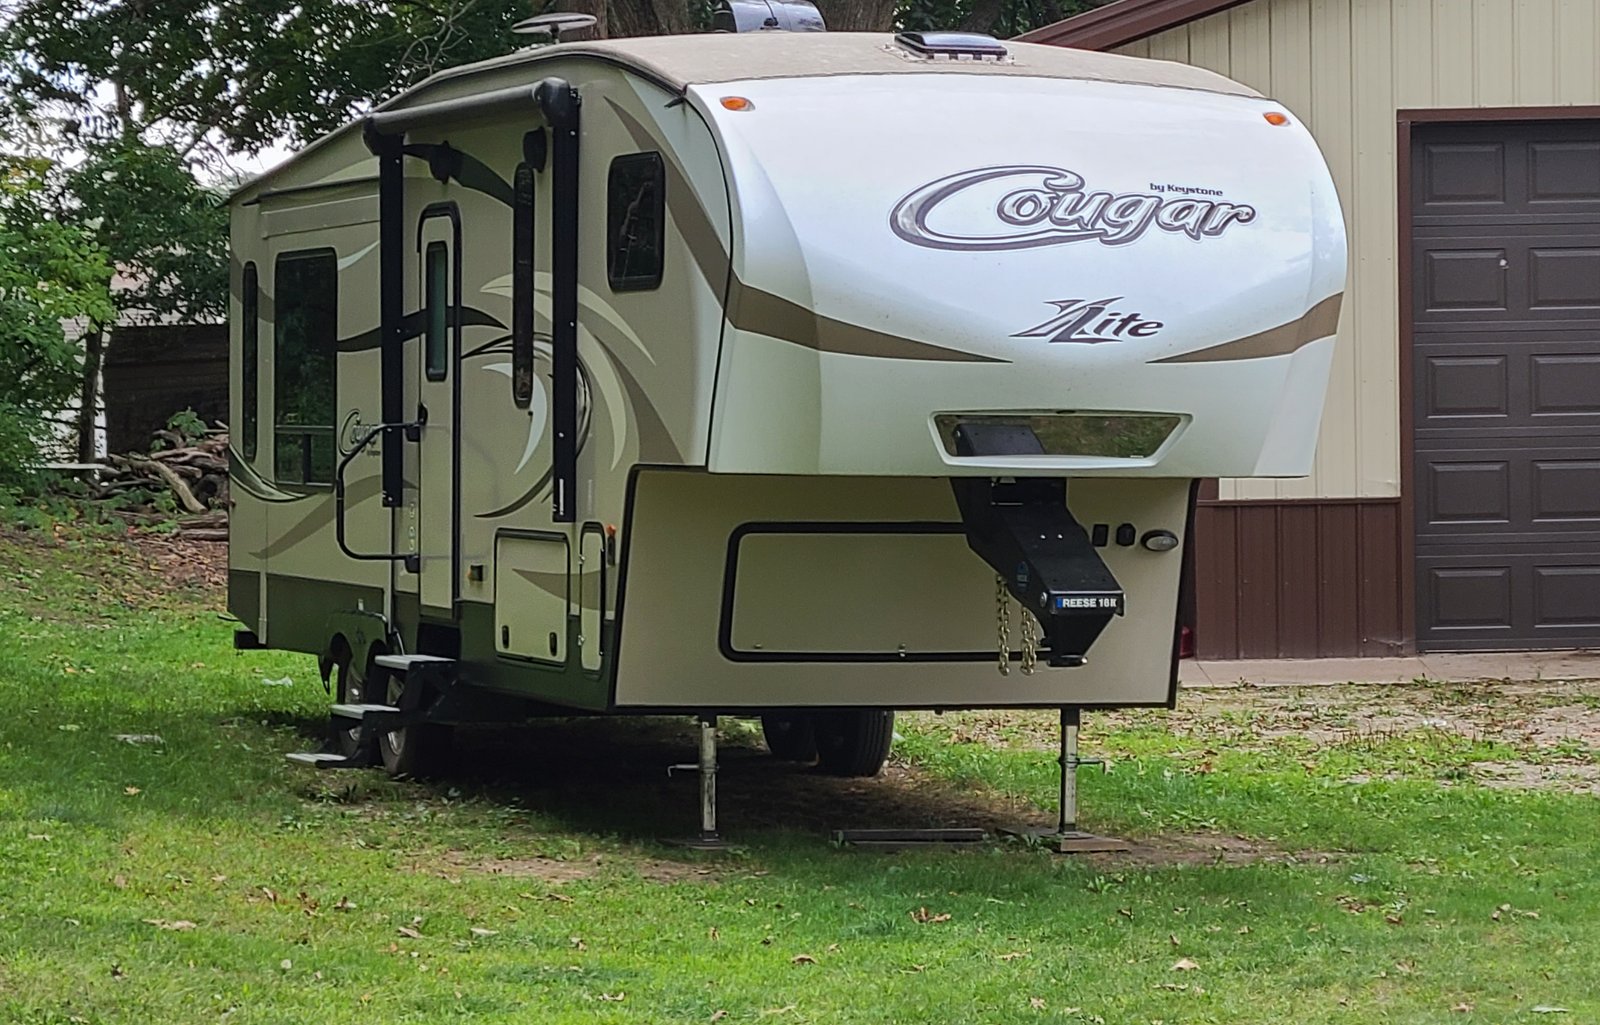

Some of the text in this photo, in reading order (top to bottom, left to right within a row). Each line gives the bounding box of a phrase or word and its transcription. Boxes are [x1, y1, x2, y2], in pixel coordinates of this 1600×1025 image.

[1149, 183, 1224, 197] by Keystone
[889, 164, 1256, 252] Cougar
[1062, 598, 1097, 609] REESE
